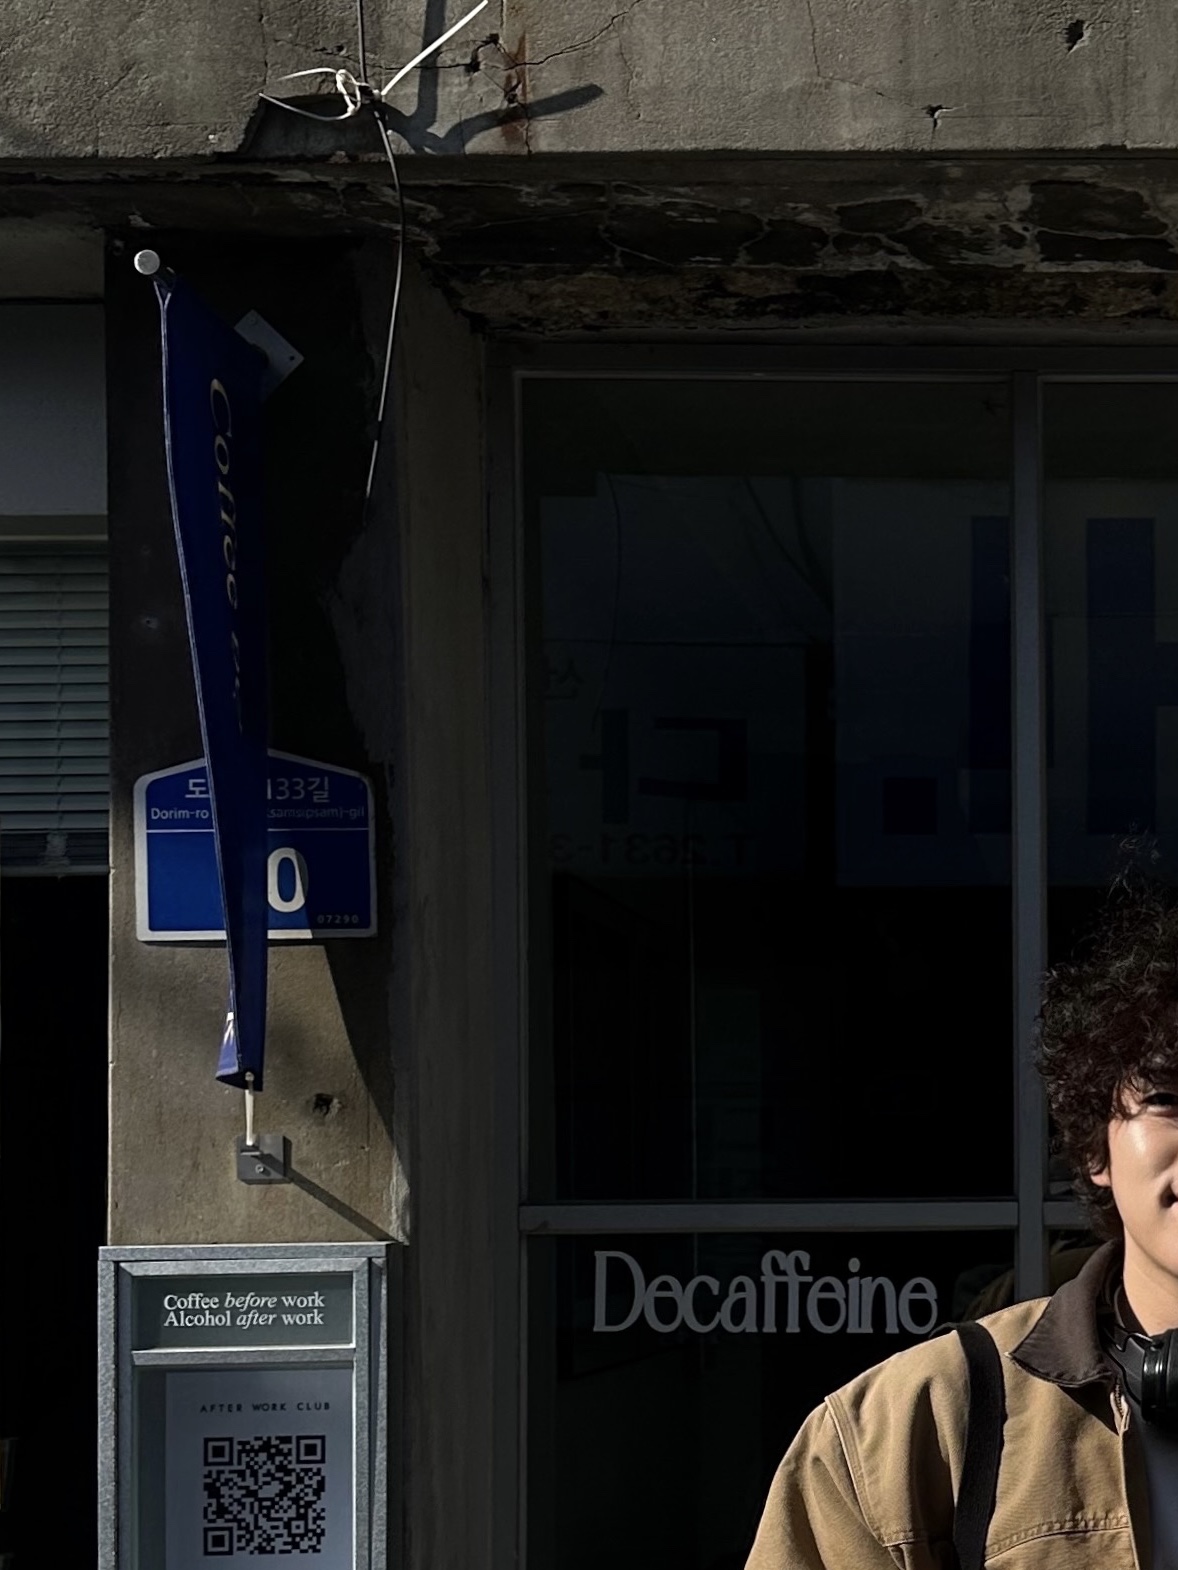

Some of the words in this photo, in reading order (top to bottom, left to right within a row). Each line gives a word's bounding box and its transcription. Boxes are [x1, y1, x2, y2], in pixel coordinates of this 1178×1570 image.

[150, 807, 209, 820] Dorim-ro
[267, 847, 309, 913] 0
[163, 1293, 220, 1311] Coffee
[224, 1292, 278, 1312] before
[281, 1291, 325, 1308] work
[592, 1249, 939, 1335] Decaffeine
[163, 1310, 232, 1327] Alcohol
[236, 1310, 278, 1330] after
[281, 1309, 324, 1326] work
[200, 1403, 243, 1413] AFTER
[252, 1402, 287, 1412] WORK
[297, 1402, 331, 1411] CLUB
